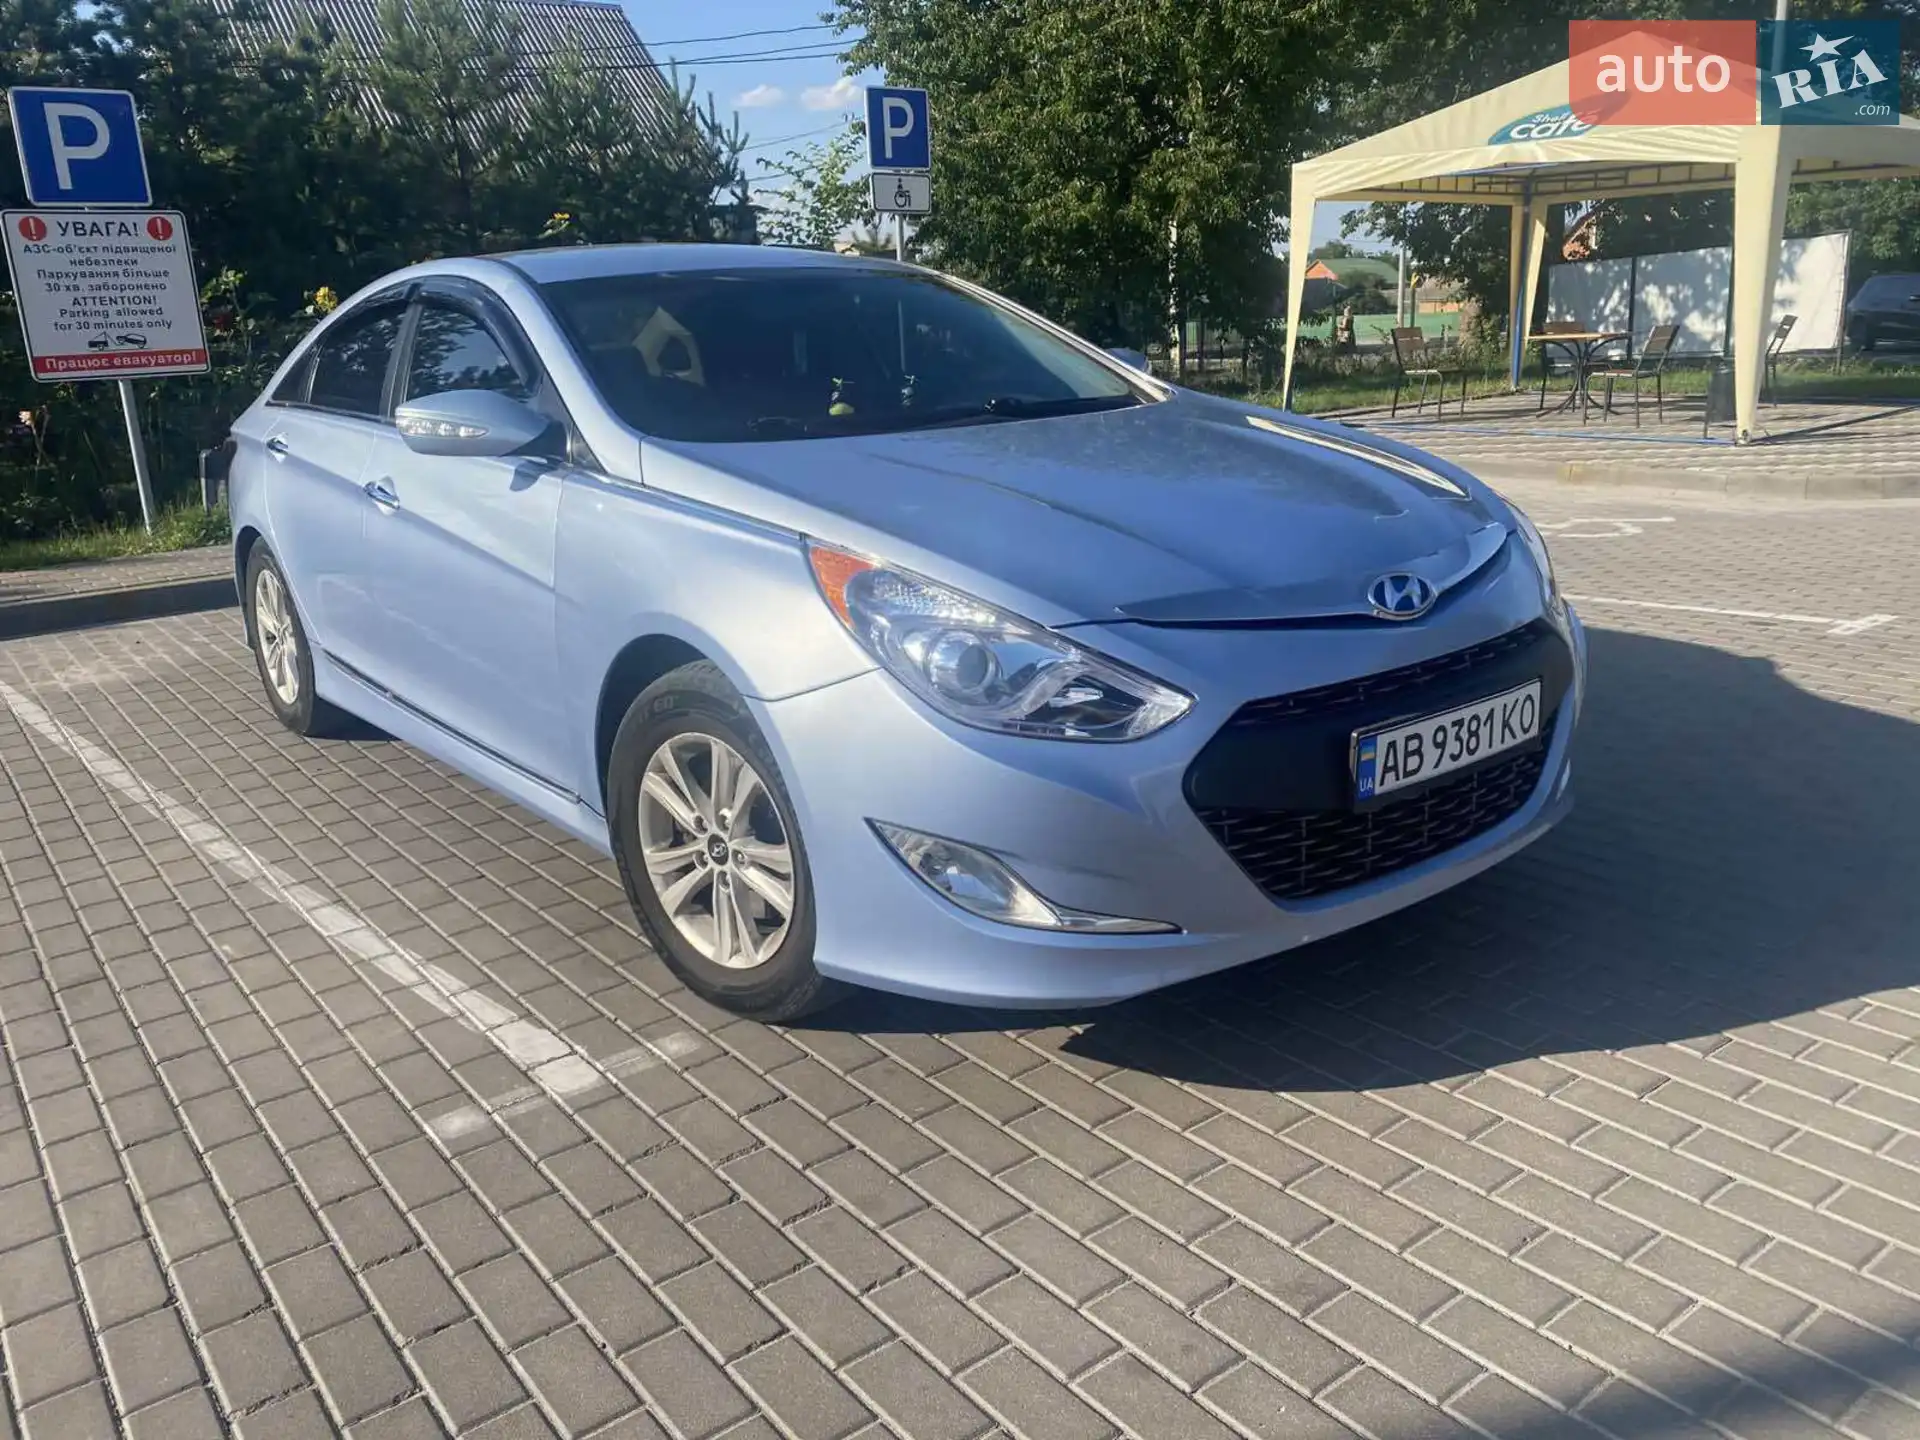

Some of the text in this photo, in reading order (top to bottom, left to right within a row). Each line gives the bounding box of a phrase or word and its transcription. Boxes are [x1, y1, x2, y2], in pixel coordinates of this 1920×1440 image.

[882, 97, 914, 159] P
[43, 102, 111, 190] P
[56, 220, 139, 237] УВАГА!
[102, 244, 176, 255] підвищеної
[69, 257, 138, 267] небезпеки
[37, 268, 170, 281] Паркування більше
[45, 283, 60, 292] 30
[88, 282, 167, 293] заборонено
[72, 296, 157, 307] ATTENTION!
[59, 306, 164, 319] Parking allowed
[54, 319, 173, 331] for 30 minutes only
[45, 350, 197, 372] Працює евакуатор!
[1359, 694, 1535, 792] UA AB 9381 KO
